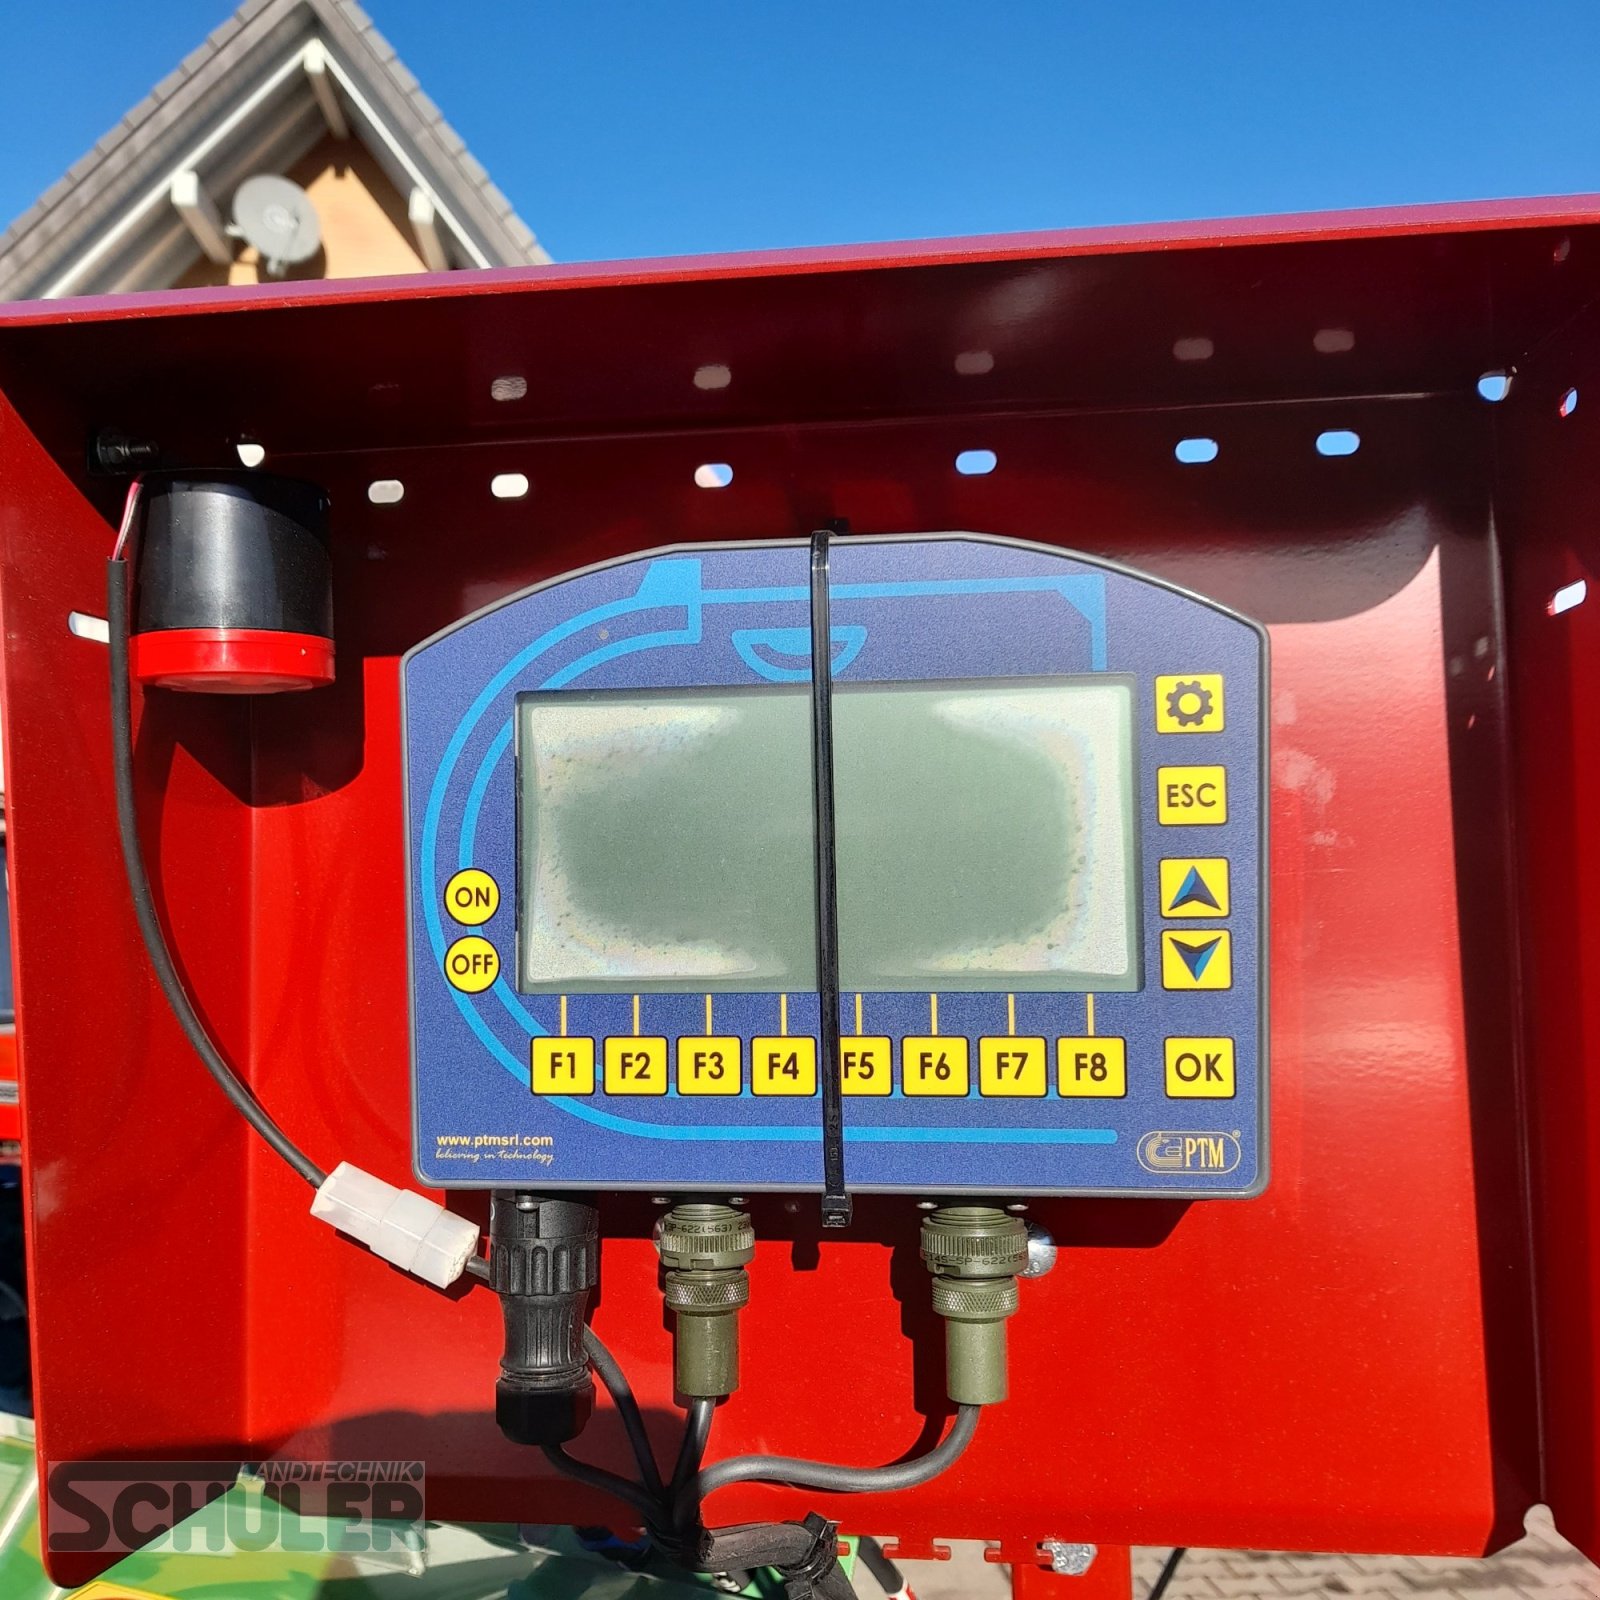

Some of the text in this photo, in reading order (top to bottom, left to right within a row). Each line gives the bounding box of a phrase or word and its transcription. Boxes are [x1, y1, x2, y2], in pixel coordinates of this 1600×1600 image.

[1168, 784, 1217, 808] ESC
[455, 887, 490, 908] ON
[452, 954, 493, 975] OFF
[551, 1053, 576, 1079] F1
[621, 1052, 650, 1079] F2
[695, 1052, 725, 1079] F3
[769, 1053, 800, 1080] F4
[844, 1052, 874, 1080] F5
[920, 1053, 951, 1080] F6
[997, 1053, 1028, 1080] F7
[1075, 1053, 1107, 1081] F8
[1176, 1053, 1223, 1082] OK
[436, 1134, 554, 1148] www.ptmsrl.com
[1185, 1138, 1225, 1168] PTM
[435, 1148, 480, 1163] believing
